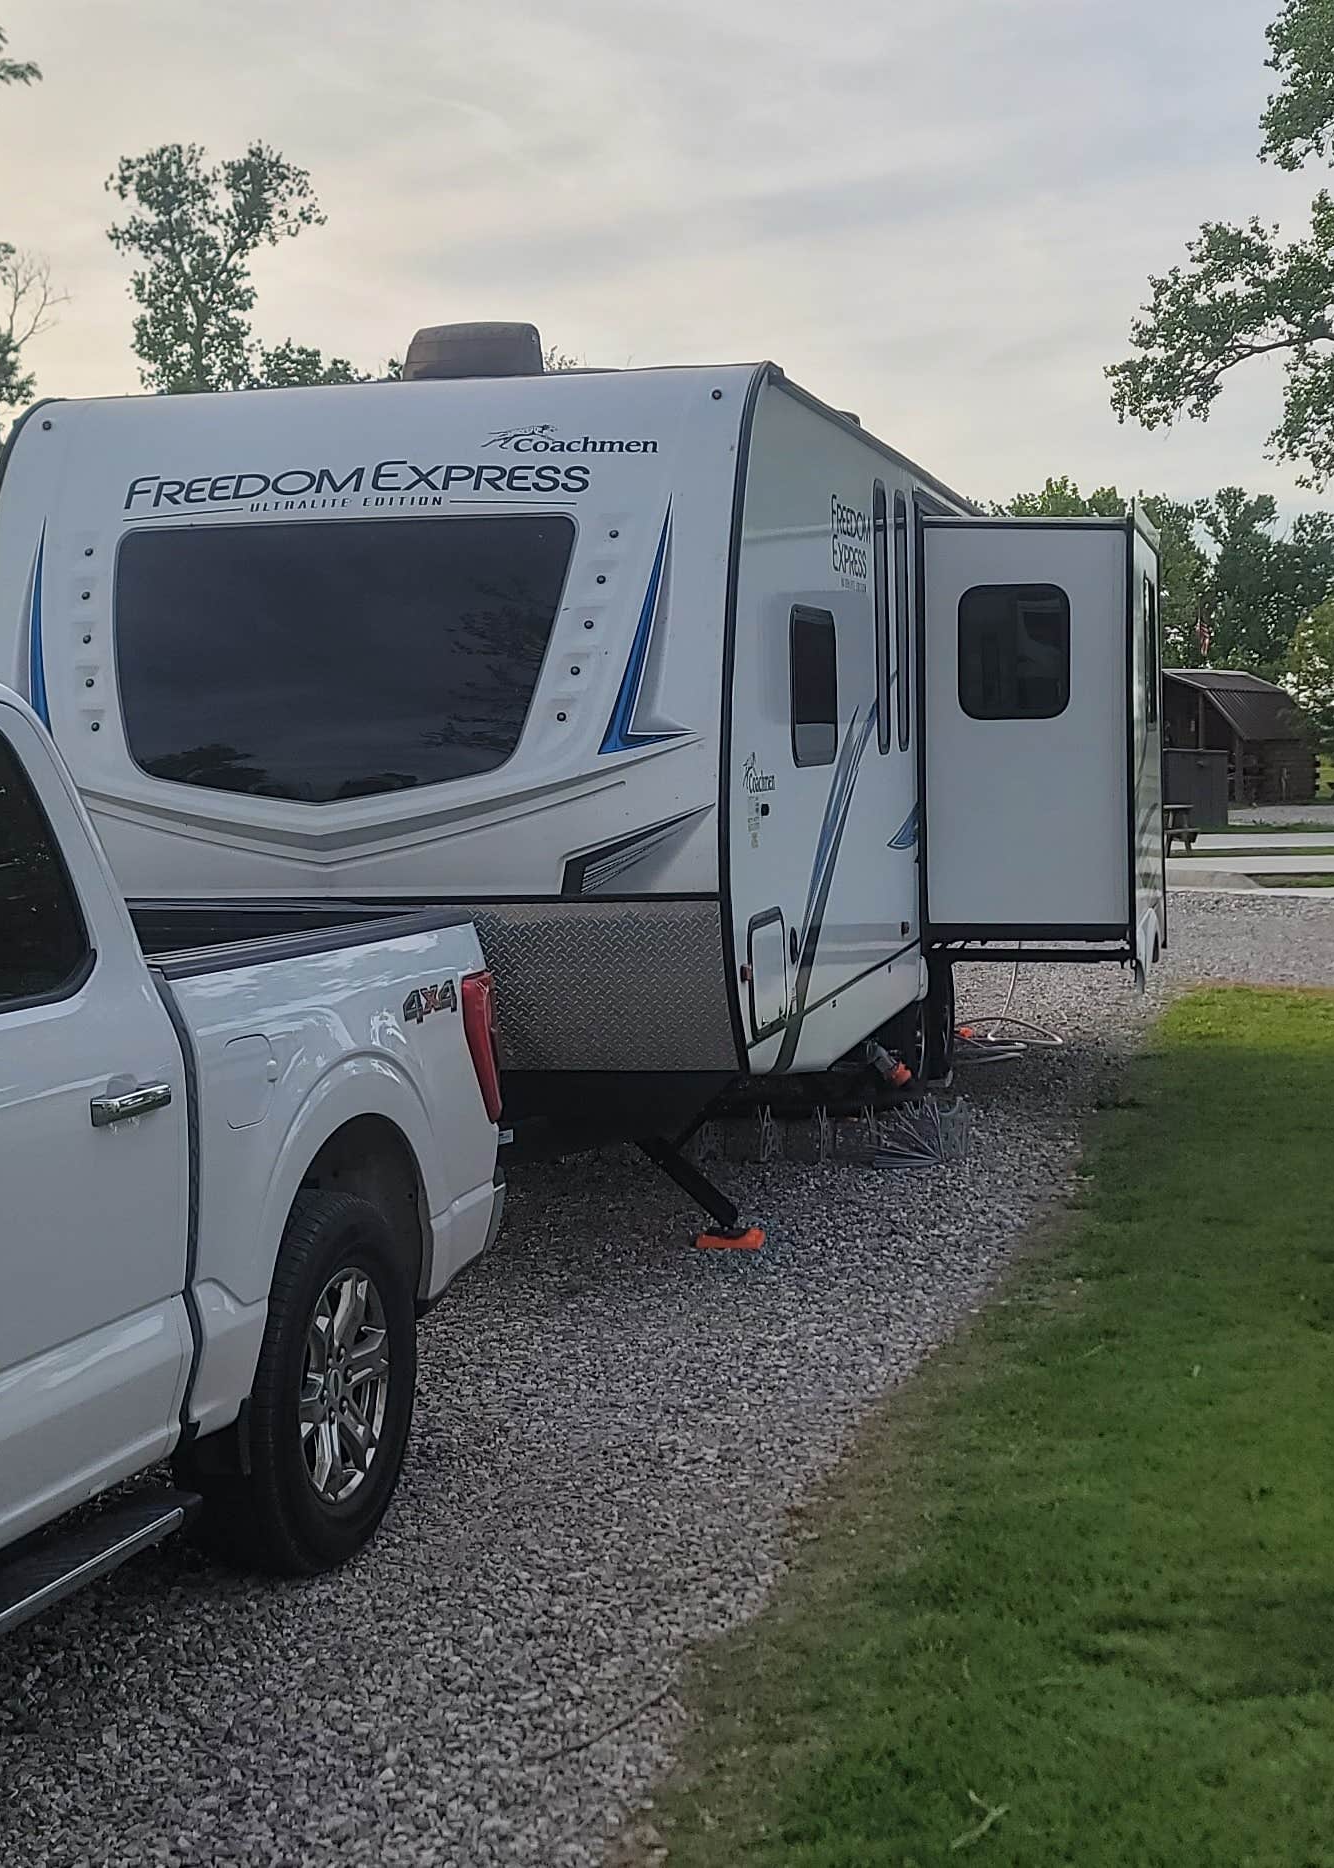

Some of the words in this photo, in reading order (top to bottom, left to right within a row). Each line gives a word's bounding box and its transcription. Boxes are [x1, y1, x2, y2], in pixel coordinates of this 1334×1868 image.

[513, 436, 659, 454] Coachmen
[123, 466, 366, 510] FREEDOM
[370, 460, 591, 493] EXPRESS
[249, 496, 350, 513] ULTRALITE
[362, 495, 443, 507] EDITION
[831, 493, 871, 545] FREEDOM
[832, 533, 867, 579] EXPRESS
